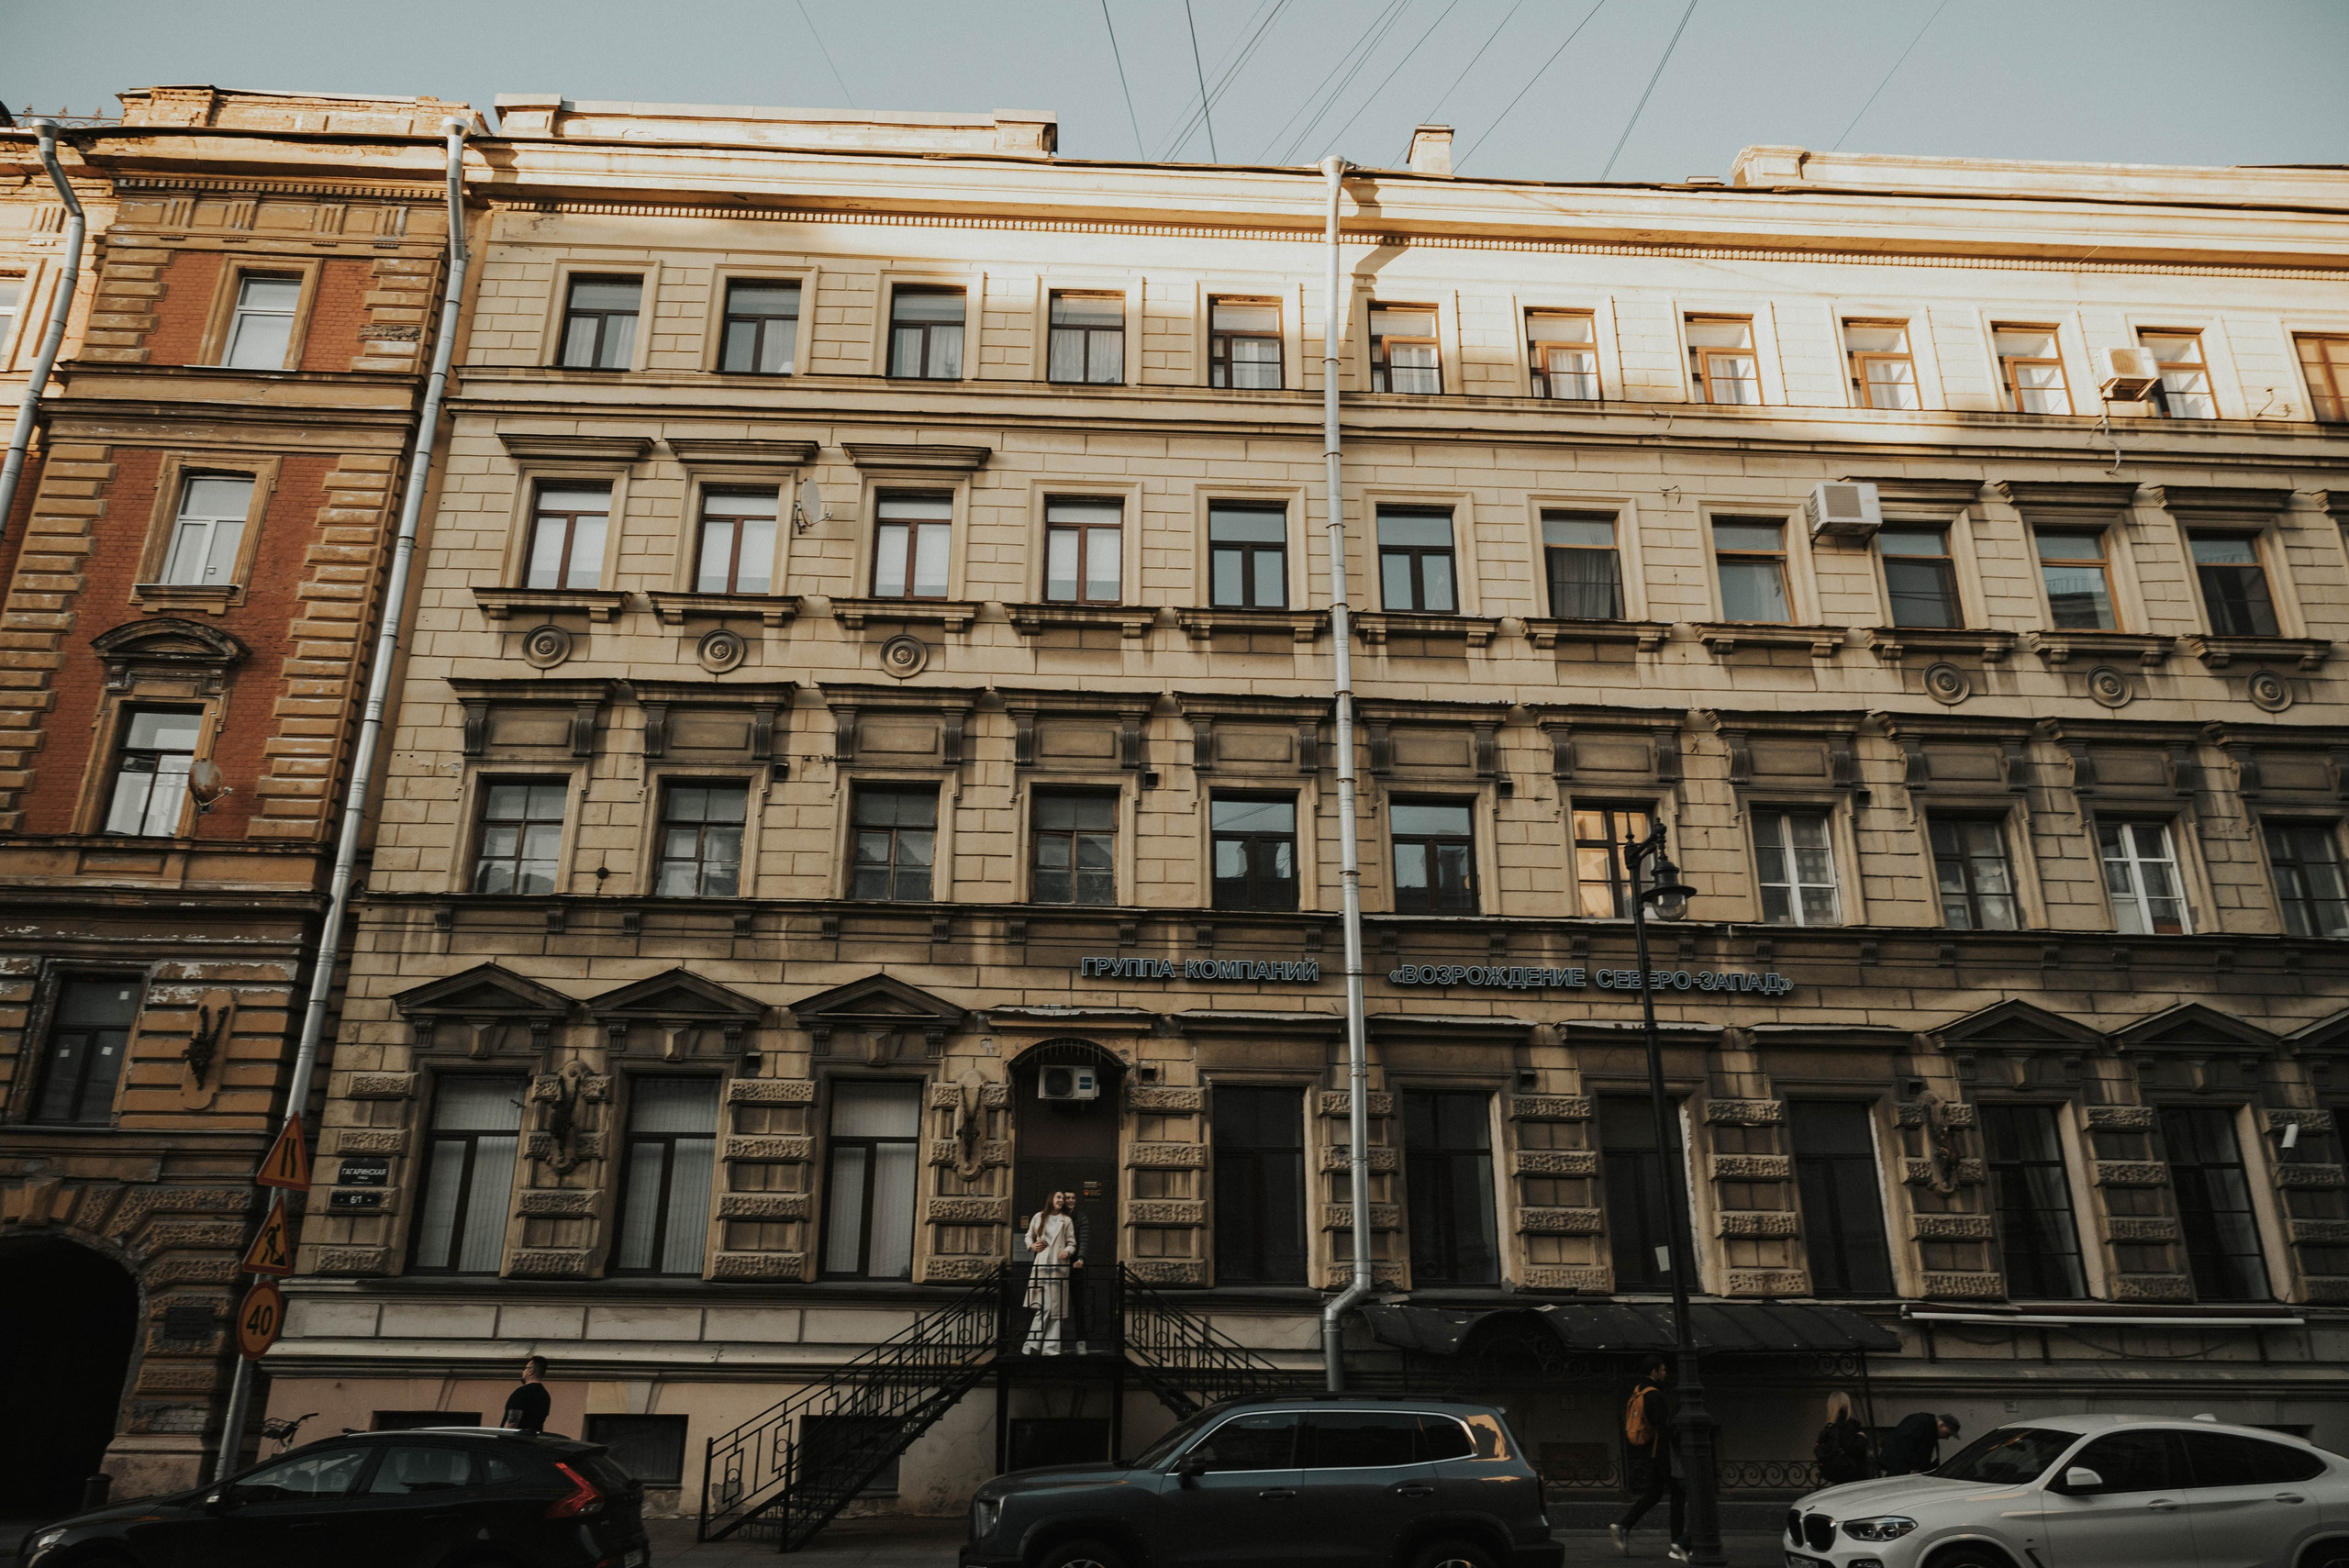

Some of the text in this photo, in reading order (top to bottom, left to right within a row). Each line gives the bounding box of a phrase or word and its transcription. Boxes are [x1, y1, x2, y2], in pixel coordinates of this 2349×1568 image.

[1081, 957, 1175, 978] ГРУППА
[1186, 957, 1319, 981] КОМПАНИЙ
[1388, 964, 1586, 989] «ВОЗРОЖДЕНИЕ
[246, 1304, 273, 1337] 40
